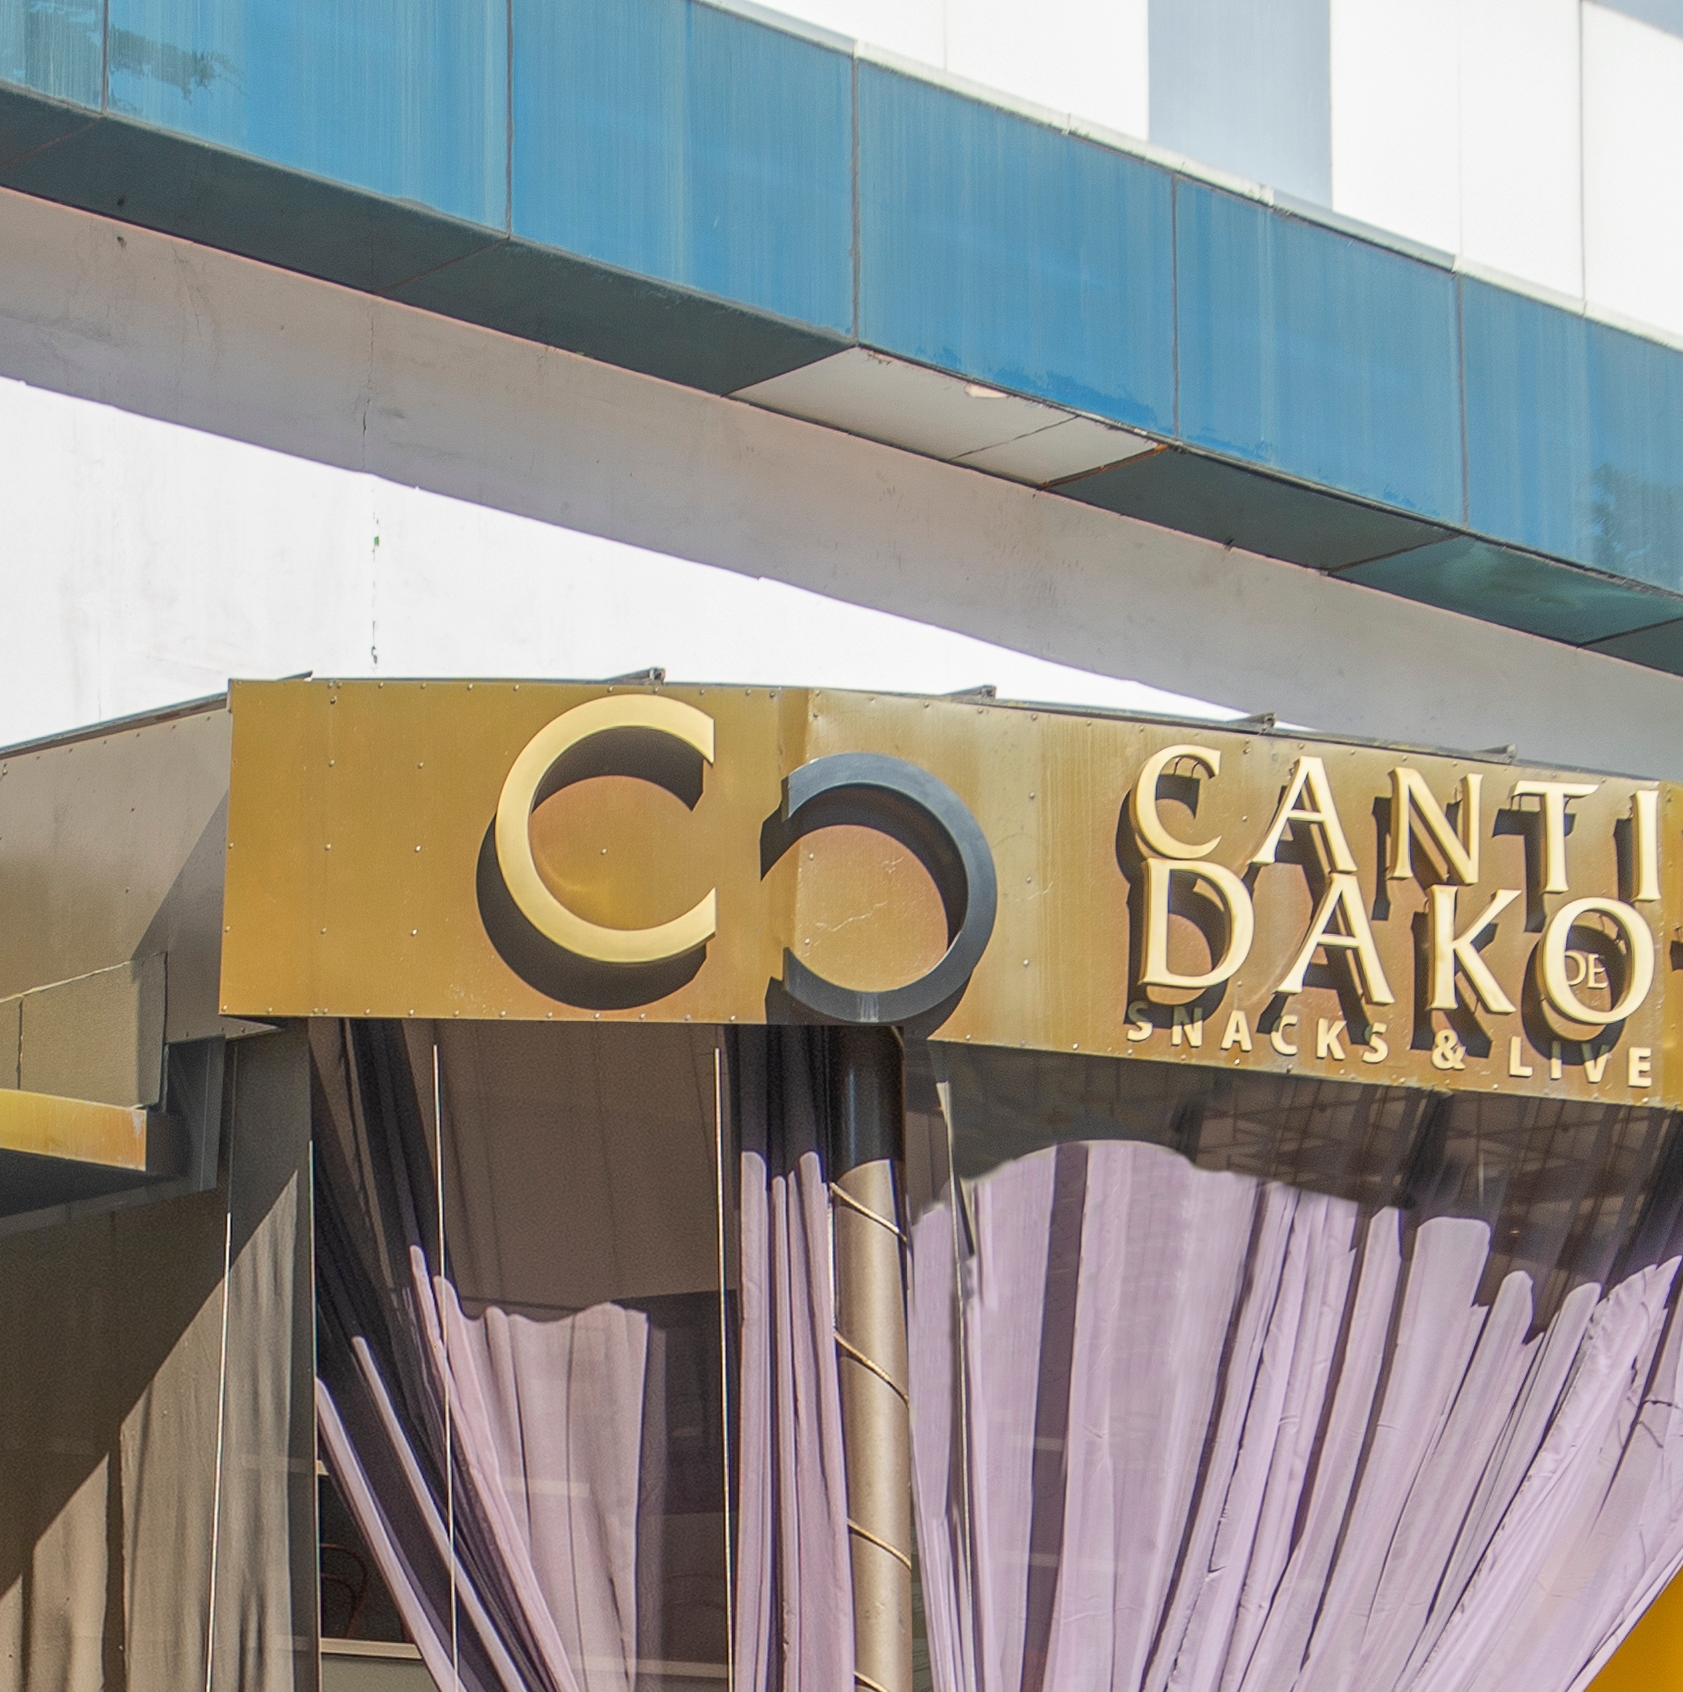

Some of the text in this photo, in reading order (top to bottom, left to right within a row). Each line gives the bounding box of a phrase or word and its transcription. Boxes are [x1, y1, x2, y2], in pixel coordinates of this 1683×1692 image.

[1565, 951, 1610, 990] DE
[1126, 1000, 1390, 1064] SNACKS
[1431, 1028, 1467, 1071] &
[1508, 1035, 1653, 1089] LIVE
